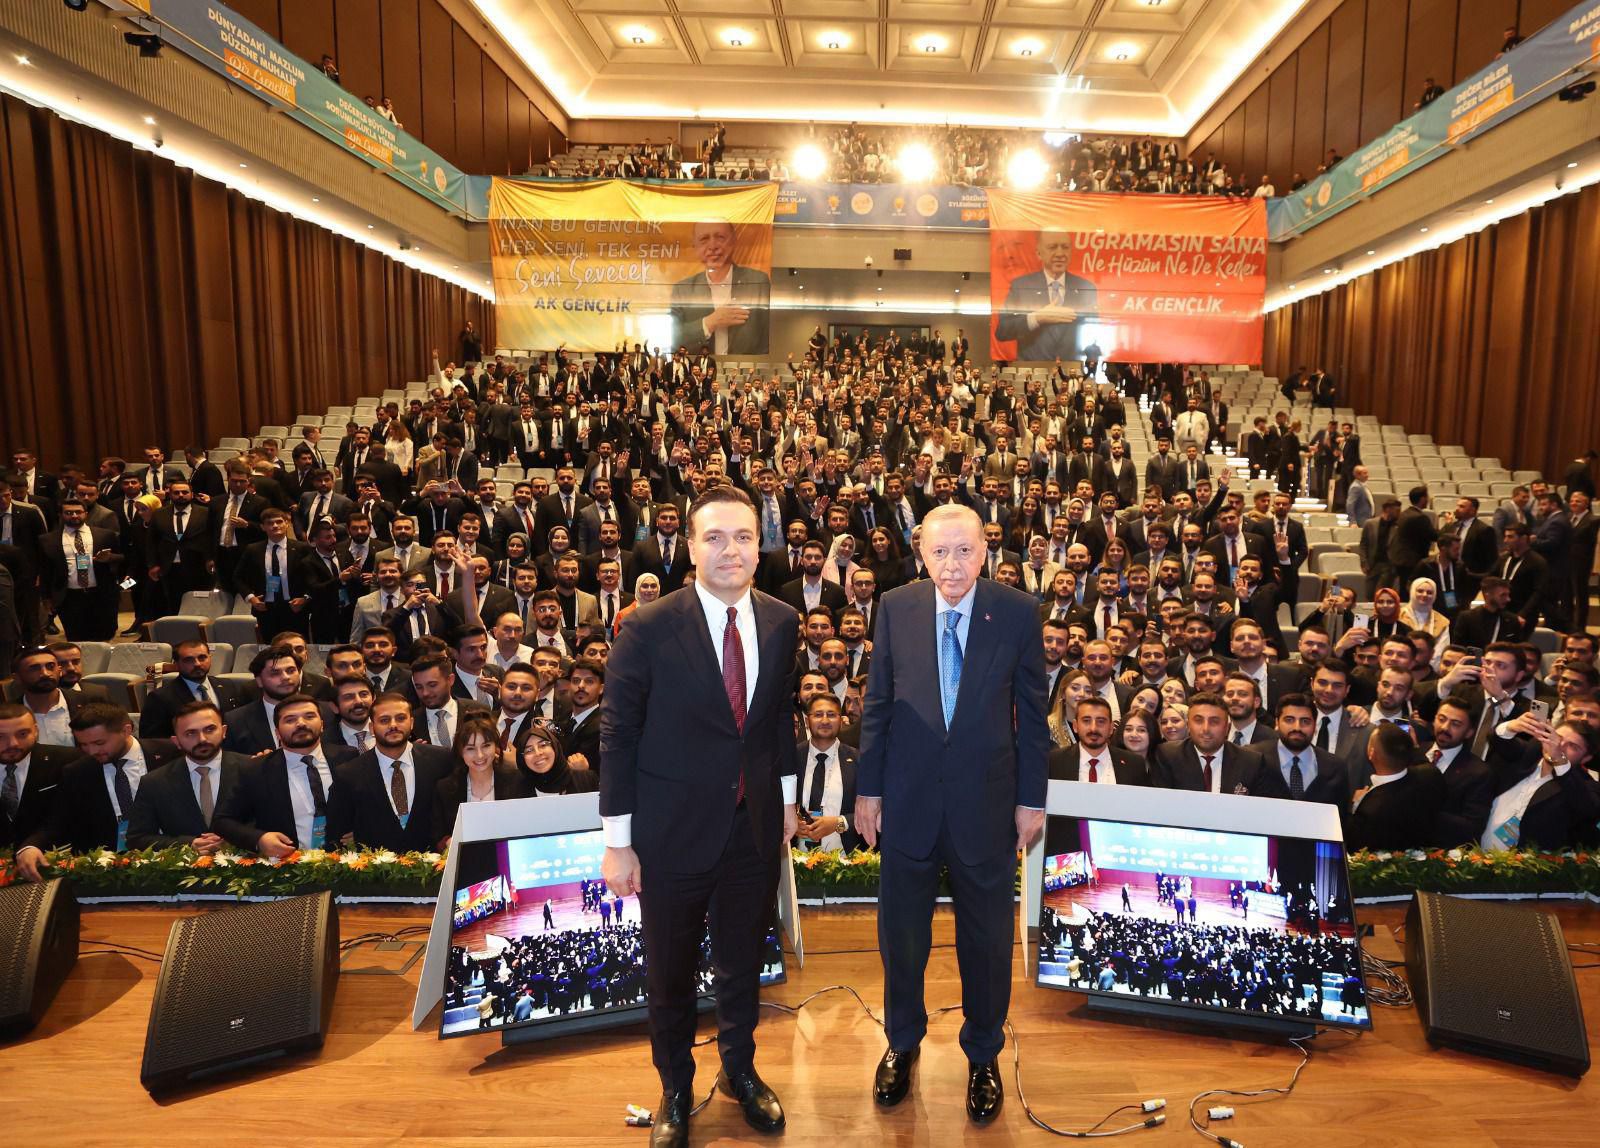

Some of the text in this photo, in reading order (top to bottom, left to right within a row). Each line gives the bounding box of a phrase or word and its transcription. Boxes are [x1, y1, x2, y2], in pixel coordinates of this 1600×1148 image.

[208, 8, 305, 81] DÜNYADAKİ MAZLUM
[220, 30, 258, 63] DÜZENE
[550, 217, 577, 232] BU
[597, 242, 632, 258] TEK
[638, 240, 681, 260] SENİ
[1209, 235, 1267, 255] SANA
[1082, 249, 1259, 282] Ne Hüzün Ne De Keder
[534, 297, 632, 316] AK GENÇLİK
[1122, 295, 1225, 316] AK GENÇLİK
